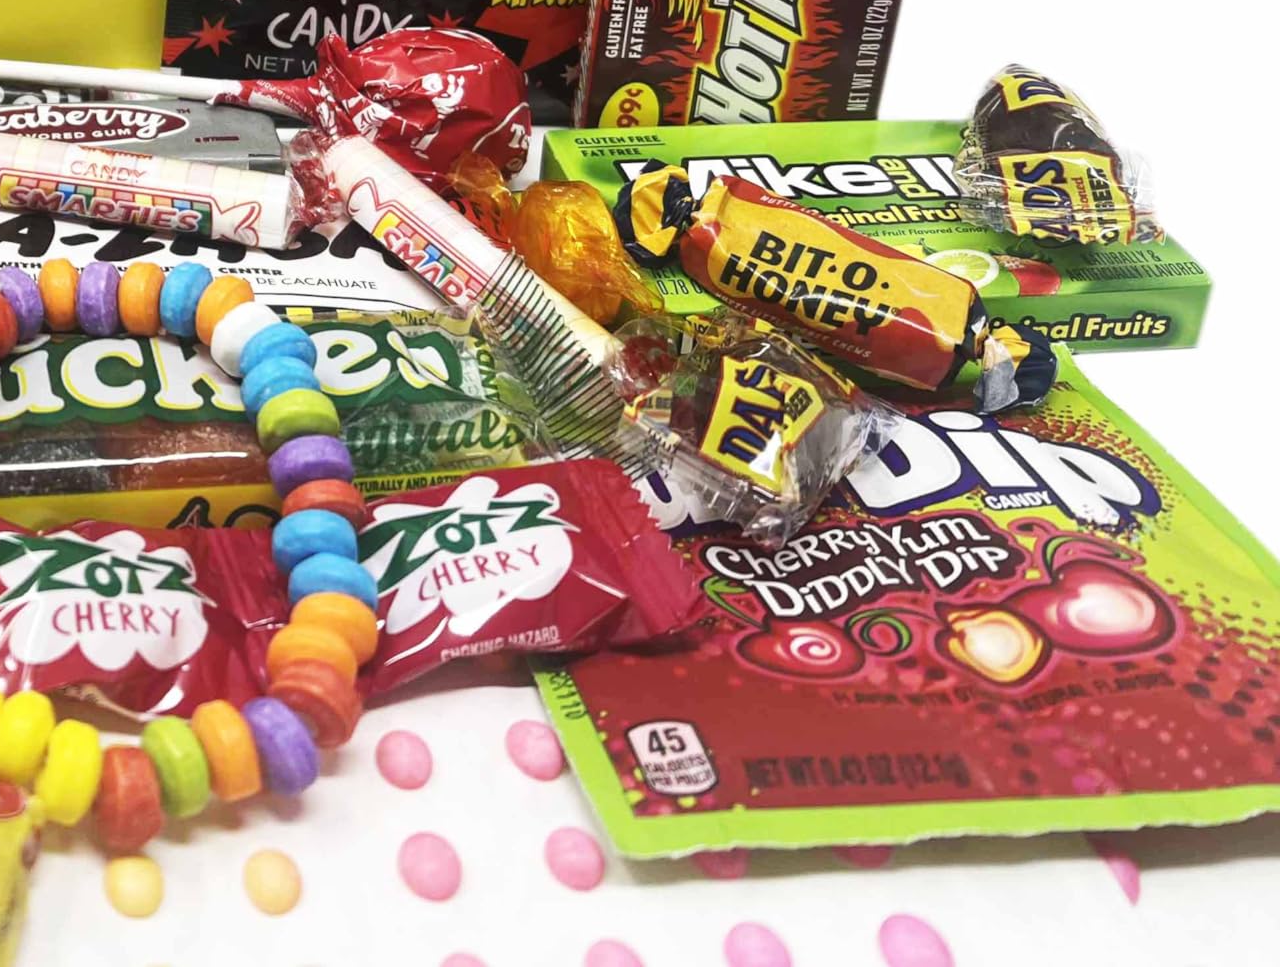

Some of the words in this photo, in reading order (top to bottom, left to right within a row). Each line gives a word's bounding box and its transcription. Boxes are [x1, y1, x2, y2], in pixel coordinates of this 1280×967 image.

[633, 5, 649, 35] FREE
[605, 19, 623, 58] GLUTEN
[860, 26, 885, 41] OZ
[628, 34, 644, 59] FAT
[855, 43, 881, 67] 0.78
[244, 52, 296, 75] NET
[845, 91, 871, 112] NET
[91, 127, 134, 141] GUM
[574, 135, 626, 148] GLUTEN
[626, 134, 660, 145] FREE
[581, 147, 609, 159] FAT
[609, 146, 642, 157] FREE
[69, 160, 148, 183] CANDY
[5, 187, 202, 233] SMARTIES
[217, 265, 284, 277] CENTER
[1142, 261, 1205, 278] FLAVORED
[258, 276, 277, 287] DE
[280, 276, 378, 292] CACAHUATE
[657, 278, 691, 297] 0.78
[719, 253, 891, 337] HONEY
[1085, 313, 1168, 339] Fruits
[846, 410, 1145, 526] Dip
[985, 491, 1053, 511] CANDY
[876, 517, 992, 557] Yum
[418, 542, 542, 602] CHERRY
[52, 599, 184, 639] CHERRY
[647, 726, 687, 757] 45
